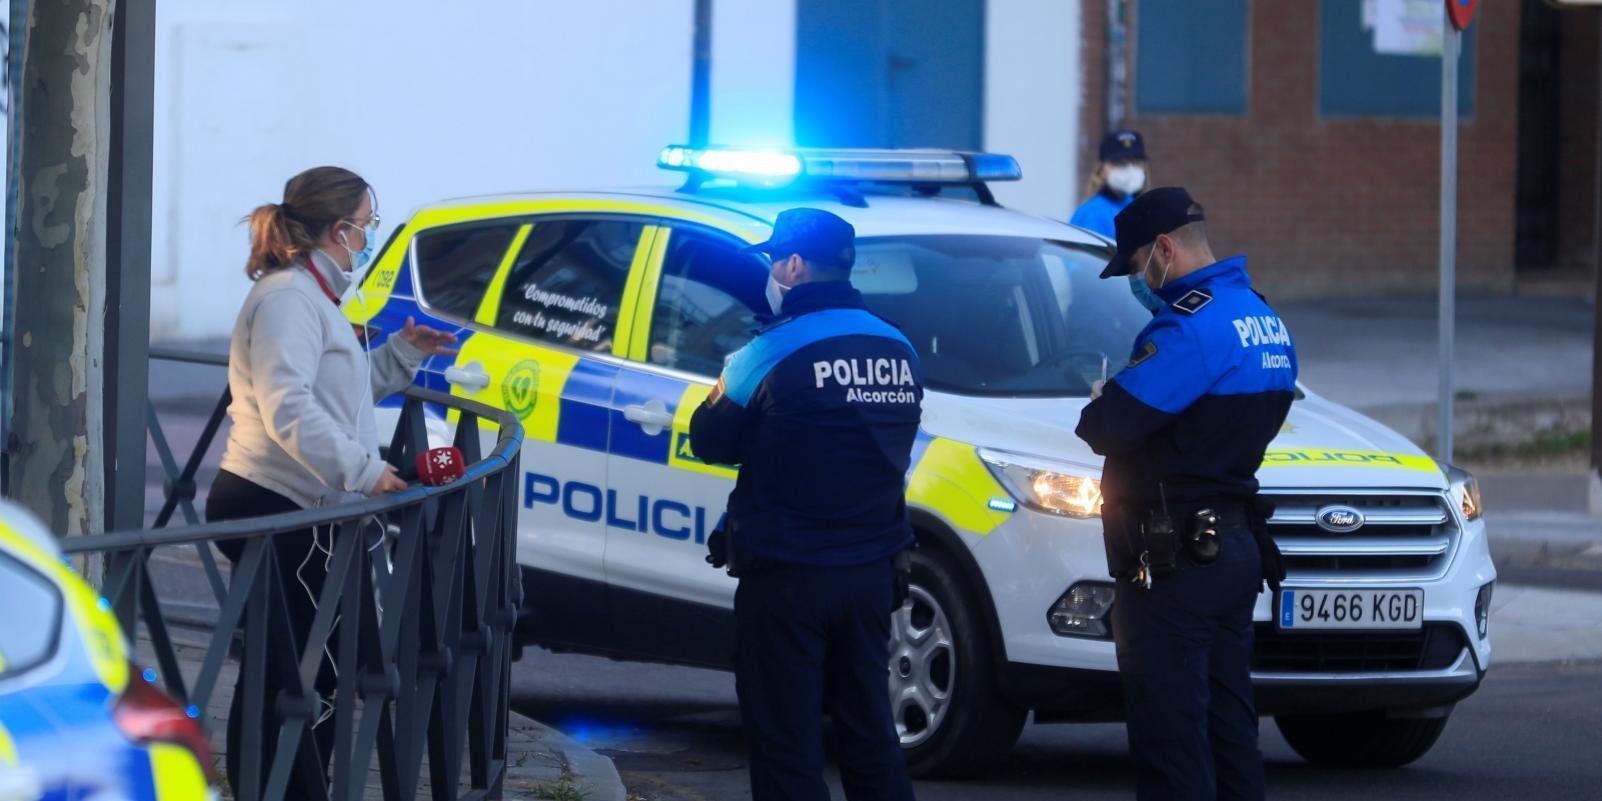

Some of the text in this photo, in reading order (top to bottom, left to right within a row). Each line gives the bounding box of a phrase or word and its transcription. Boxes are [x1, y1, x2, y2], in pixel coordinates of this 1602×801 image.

[513, 311, 533, 325] con
[813, 358, 915, 388] POLICIA
[846, 387, 915, 403] Alcorcón
[1330, 511, 1354, 525] Ford
[1300, 594, 1363, 622] 9466
[1372, 594, 1417, 622] KGD
